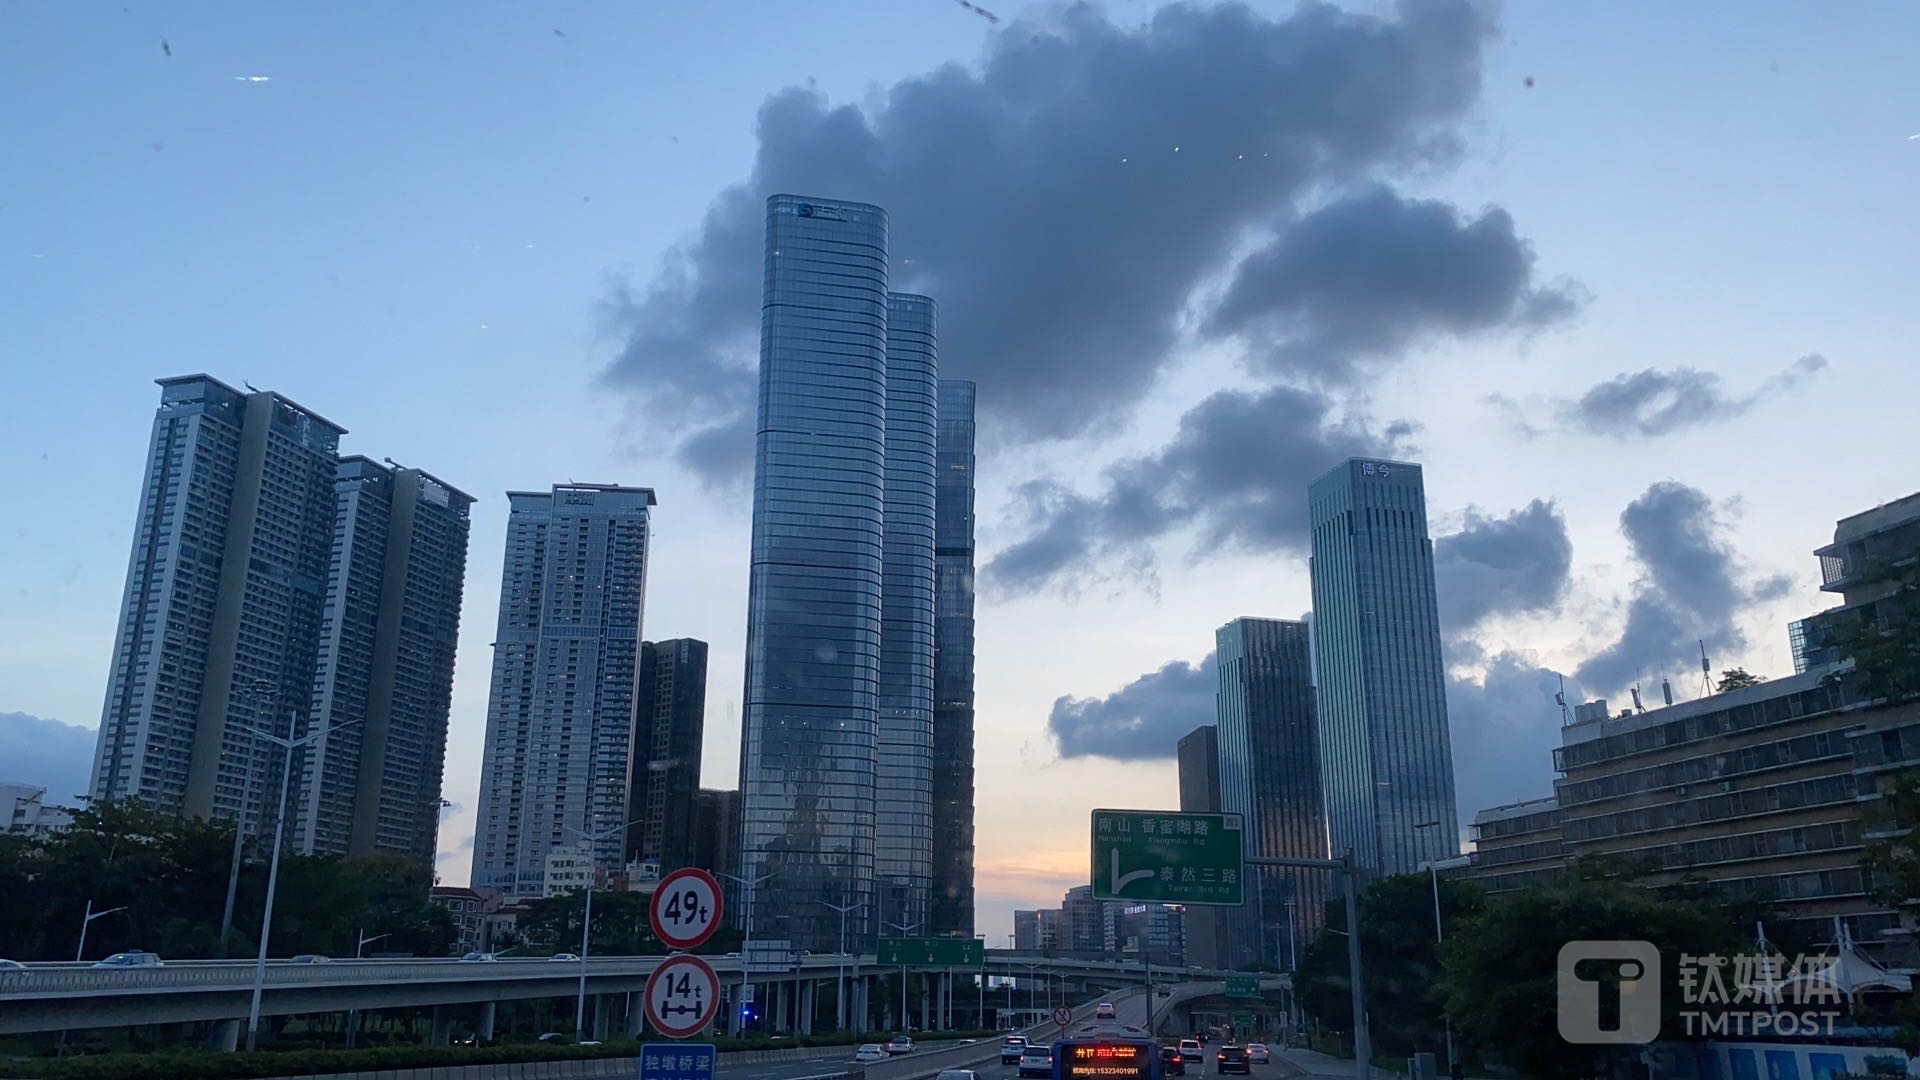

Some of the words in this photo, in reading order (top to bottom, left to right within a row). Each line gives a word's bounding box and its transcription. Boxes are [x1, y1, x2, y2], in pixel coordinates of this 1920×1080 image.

[1100, 817, 1130, 833] 南山
[1142, 818, 1208, 836] 香蜜湖路
[1160, 866, 1237, 884] 泰然三路
[664, 890, 708, 925] 49t
[645, 1055, 710, 1071] 独墩桥梁
